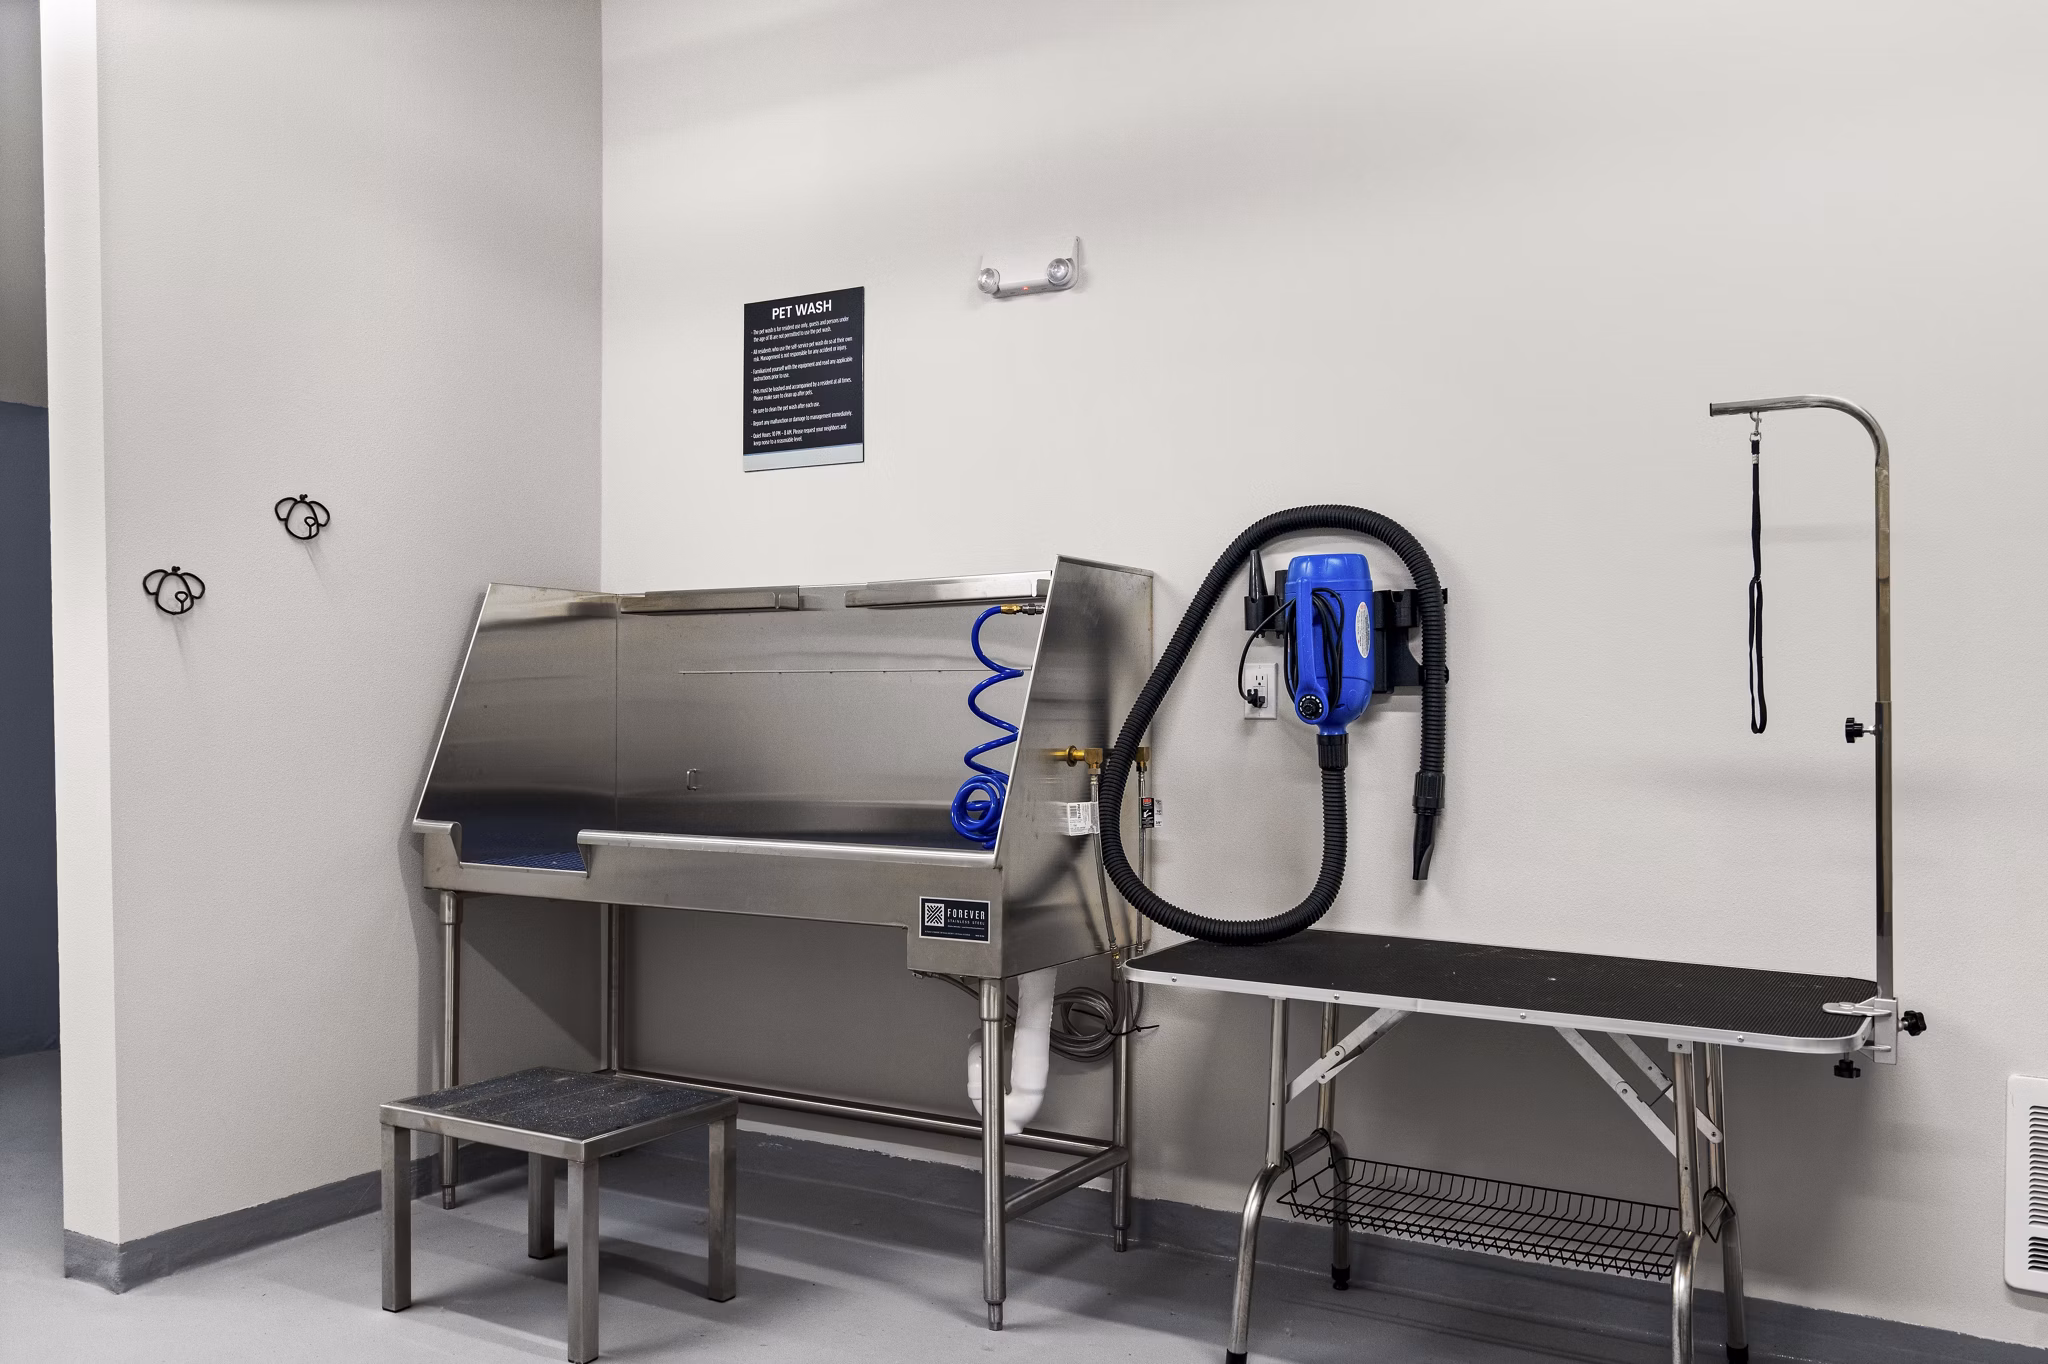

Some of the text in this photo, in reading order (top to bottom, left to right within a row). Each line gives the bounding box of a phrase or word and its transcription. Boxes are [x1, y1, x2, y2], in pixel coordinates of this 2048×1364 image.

[772, 299, 832, 320] PET WASH
[947, 908, 985, 920] FOREVER
